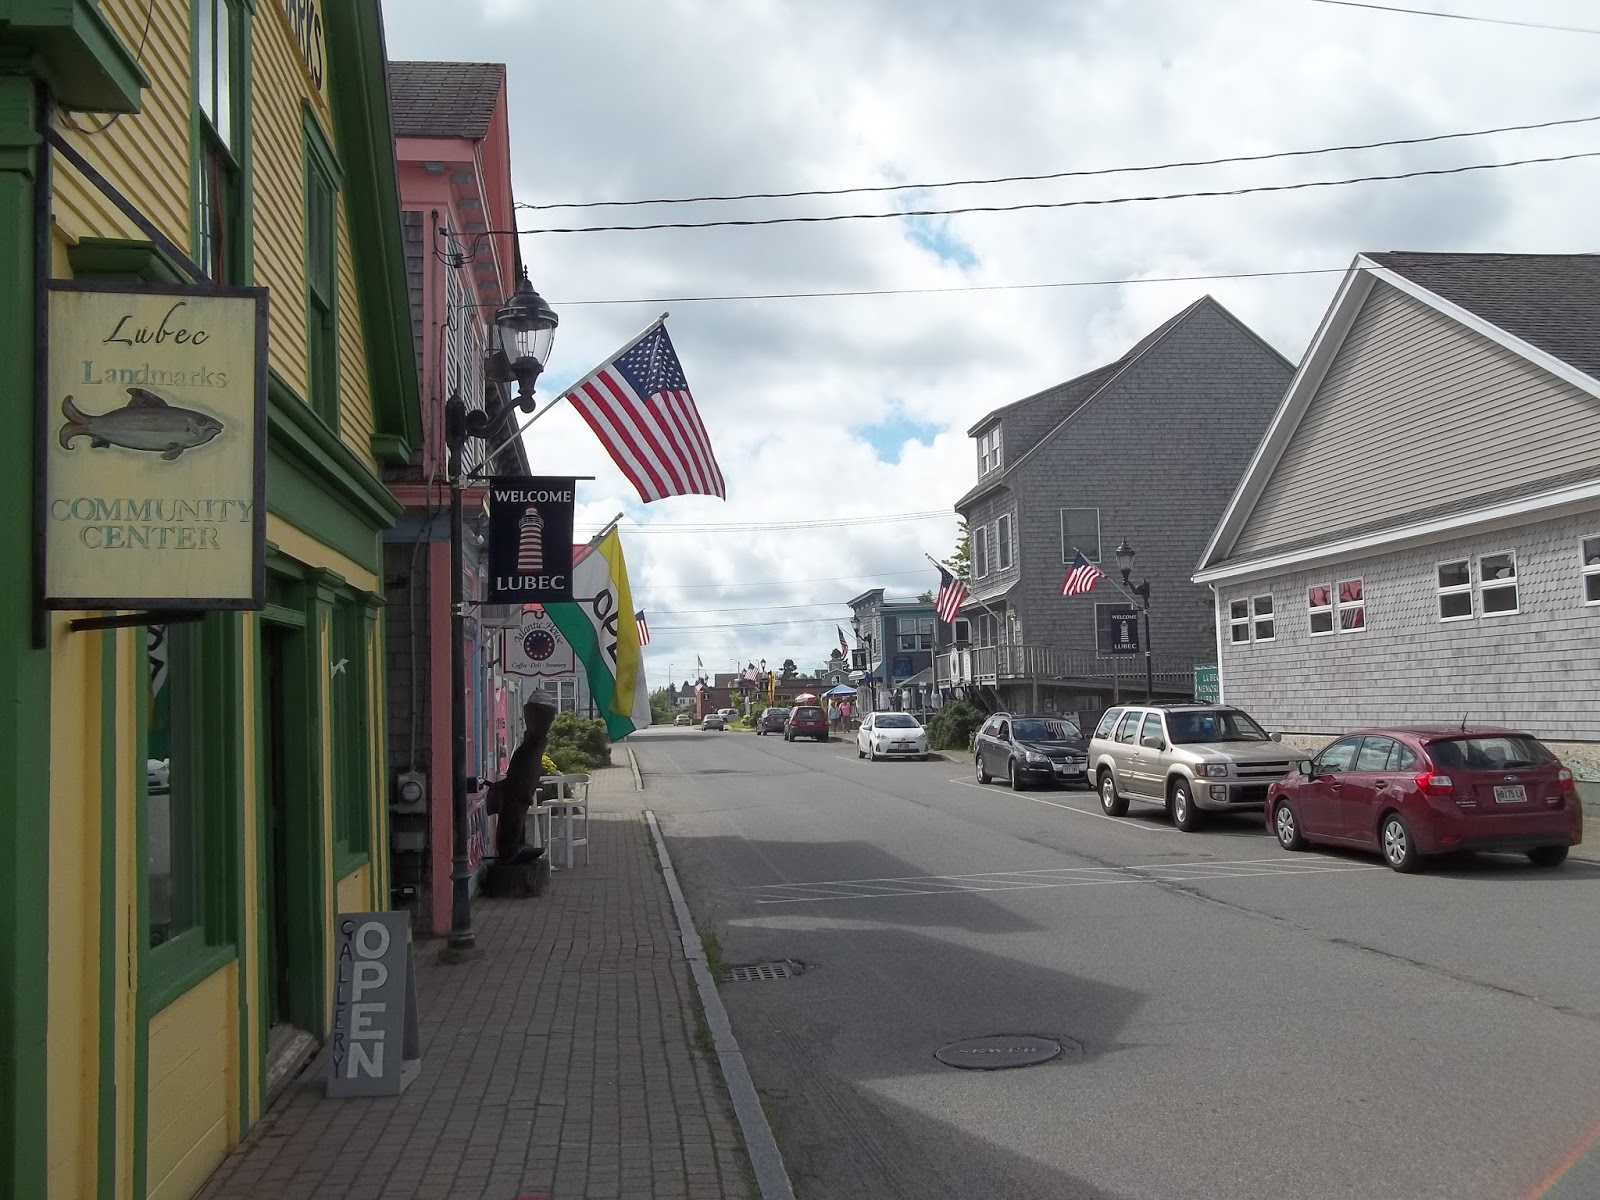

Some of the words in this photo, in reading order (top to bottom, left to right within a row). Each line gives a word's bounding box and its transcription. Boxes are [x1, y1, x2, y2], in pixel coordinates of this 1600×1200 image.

[103, 301, 209, 346] Lubec
[82, 360, 228, 389] Landmarks
[495, 490, 572, 503] WELCOME
[50, 498, 254, 523] COMMUNITY
[80, 525, 220, 550] CENTER
[496, 575, 565, 591] LUBEC
[514, 621, 543, 646] Atlantic
[544, 621, 563, 645] House
[333, 920, 355, 1078] GALLERY
[346, 921, 391, 1078] OPEN
